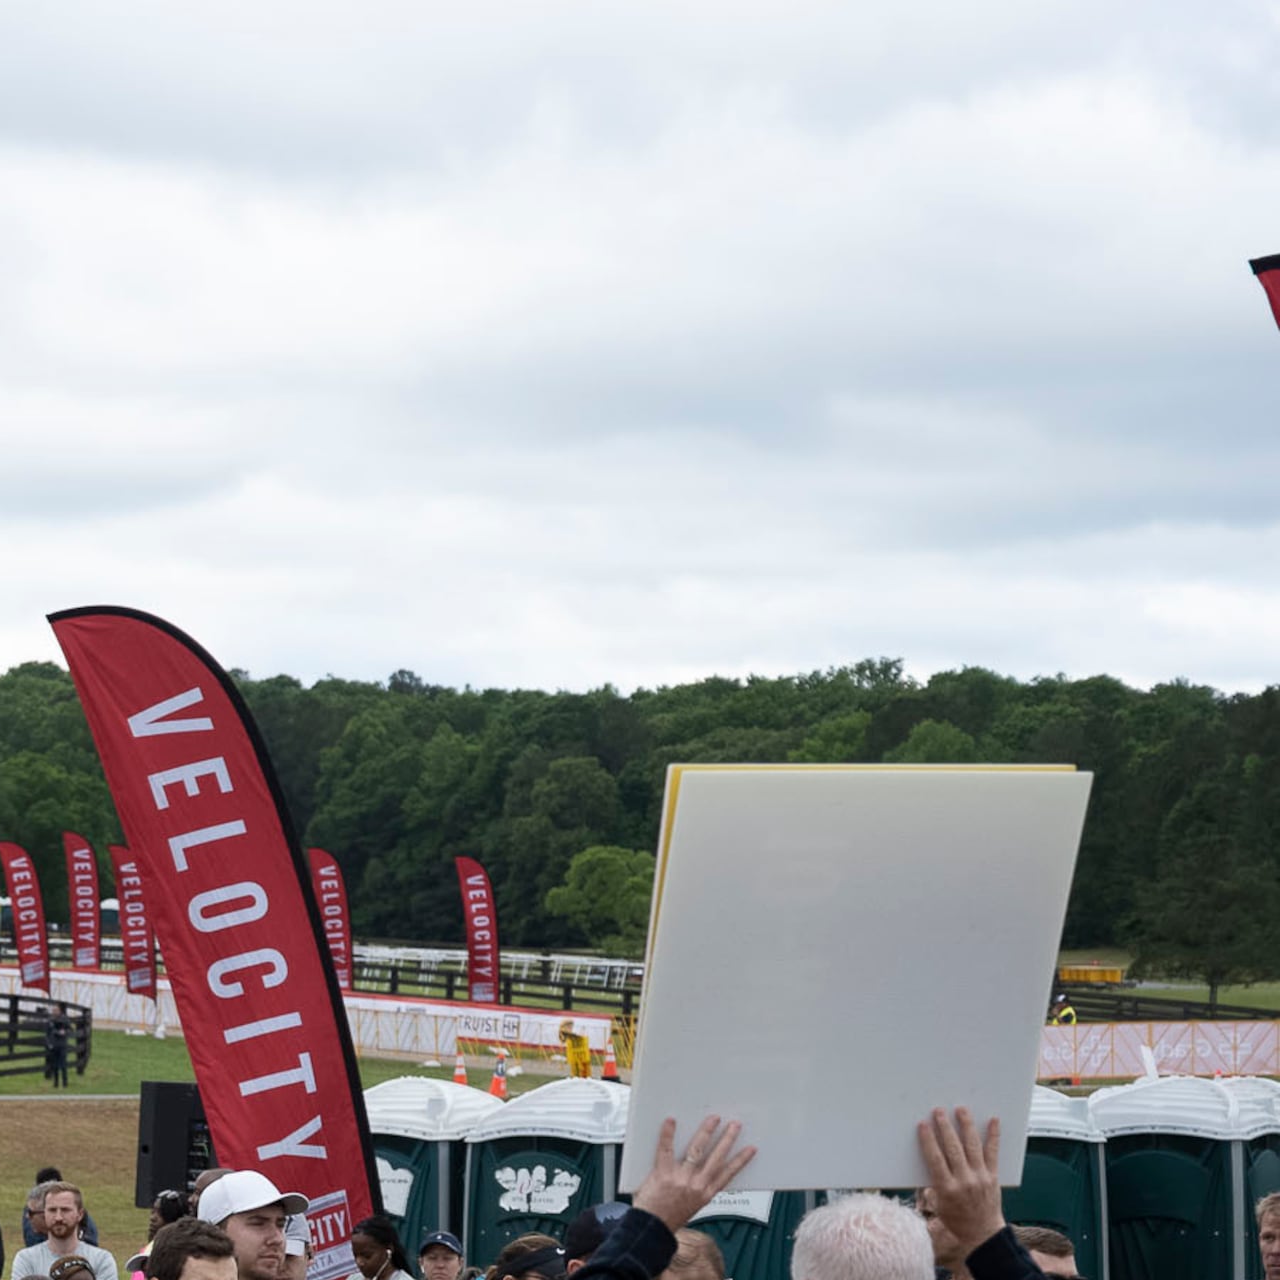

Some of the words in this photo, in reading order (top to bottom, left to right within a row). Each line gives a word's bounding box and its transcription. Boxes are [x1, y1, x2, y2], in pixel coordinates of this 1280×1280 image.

[9, 856, 42, 956] VELOCITY
[72, 847, 96, 942] VELOCITY
[119, 861, 149, 963] VELOCITY
[128, 687, 328, 1162] VELOCITY
[466, 873, 493, 978] VELOCITY
